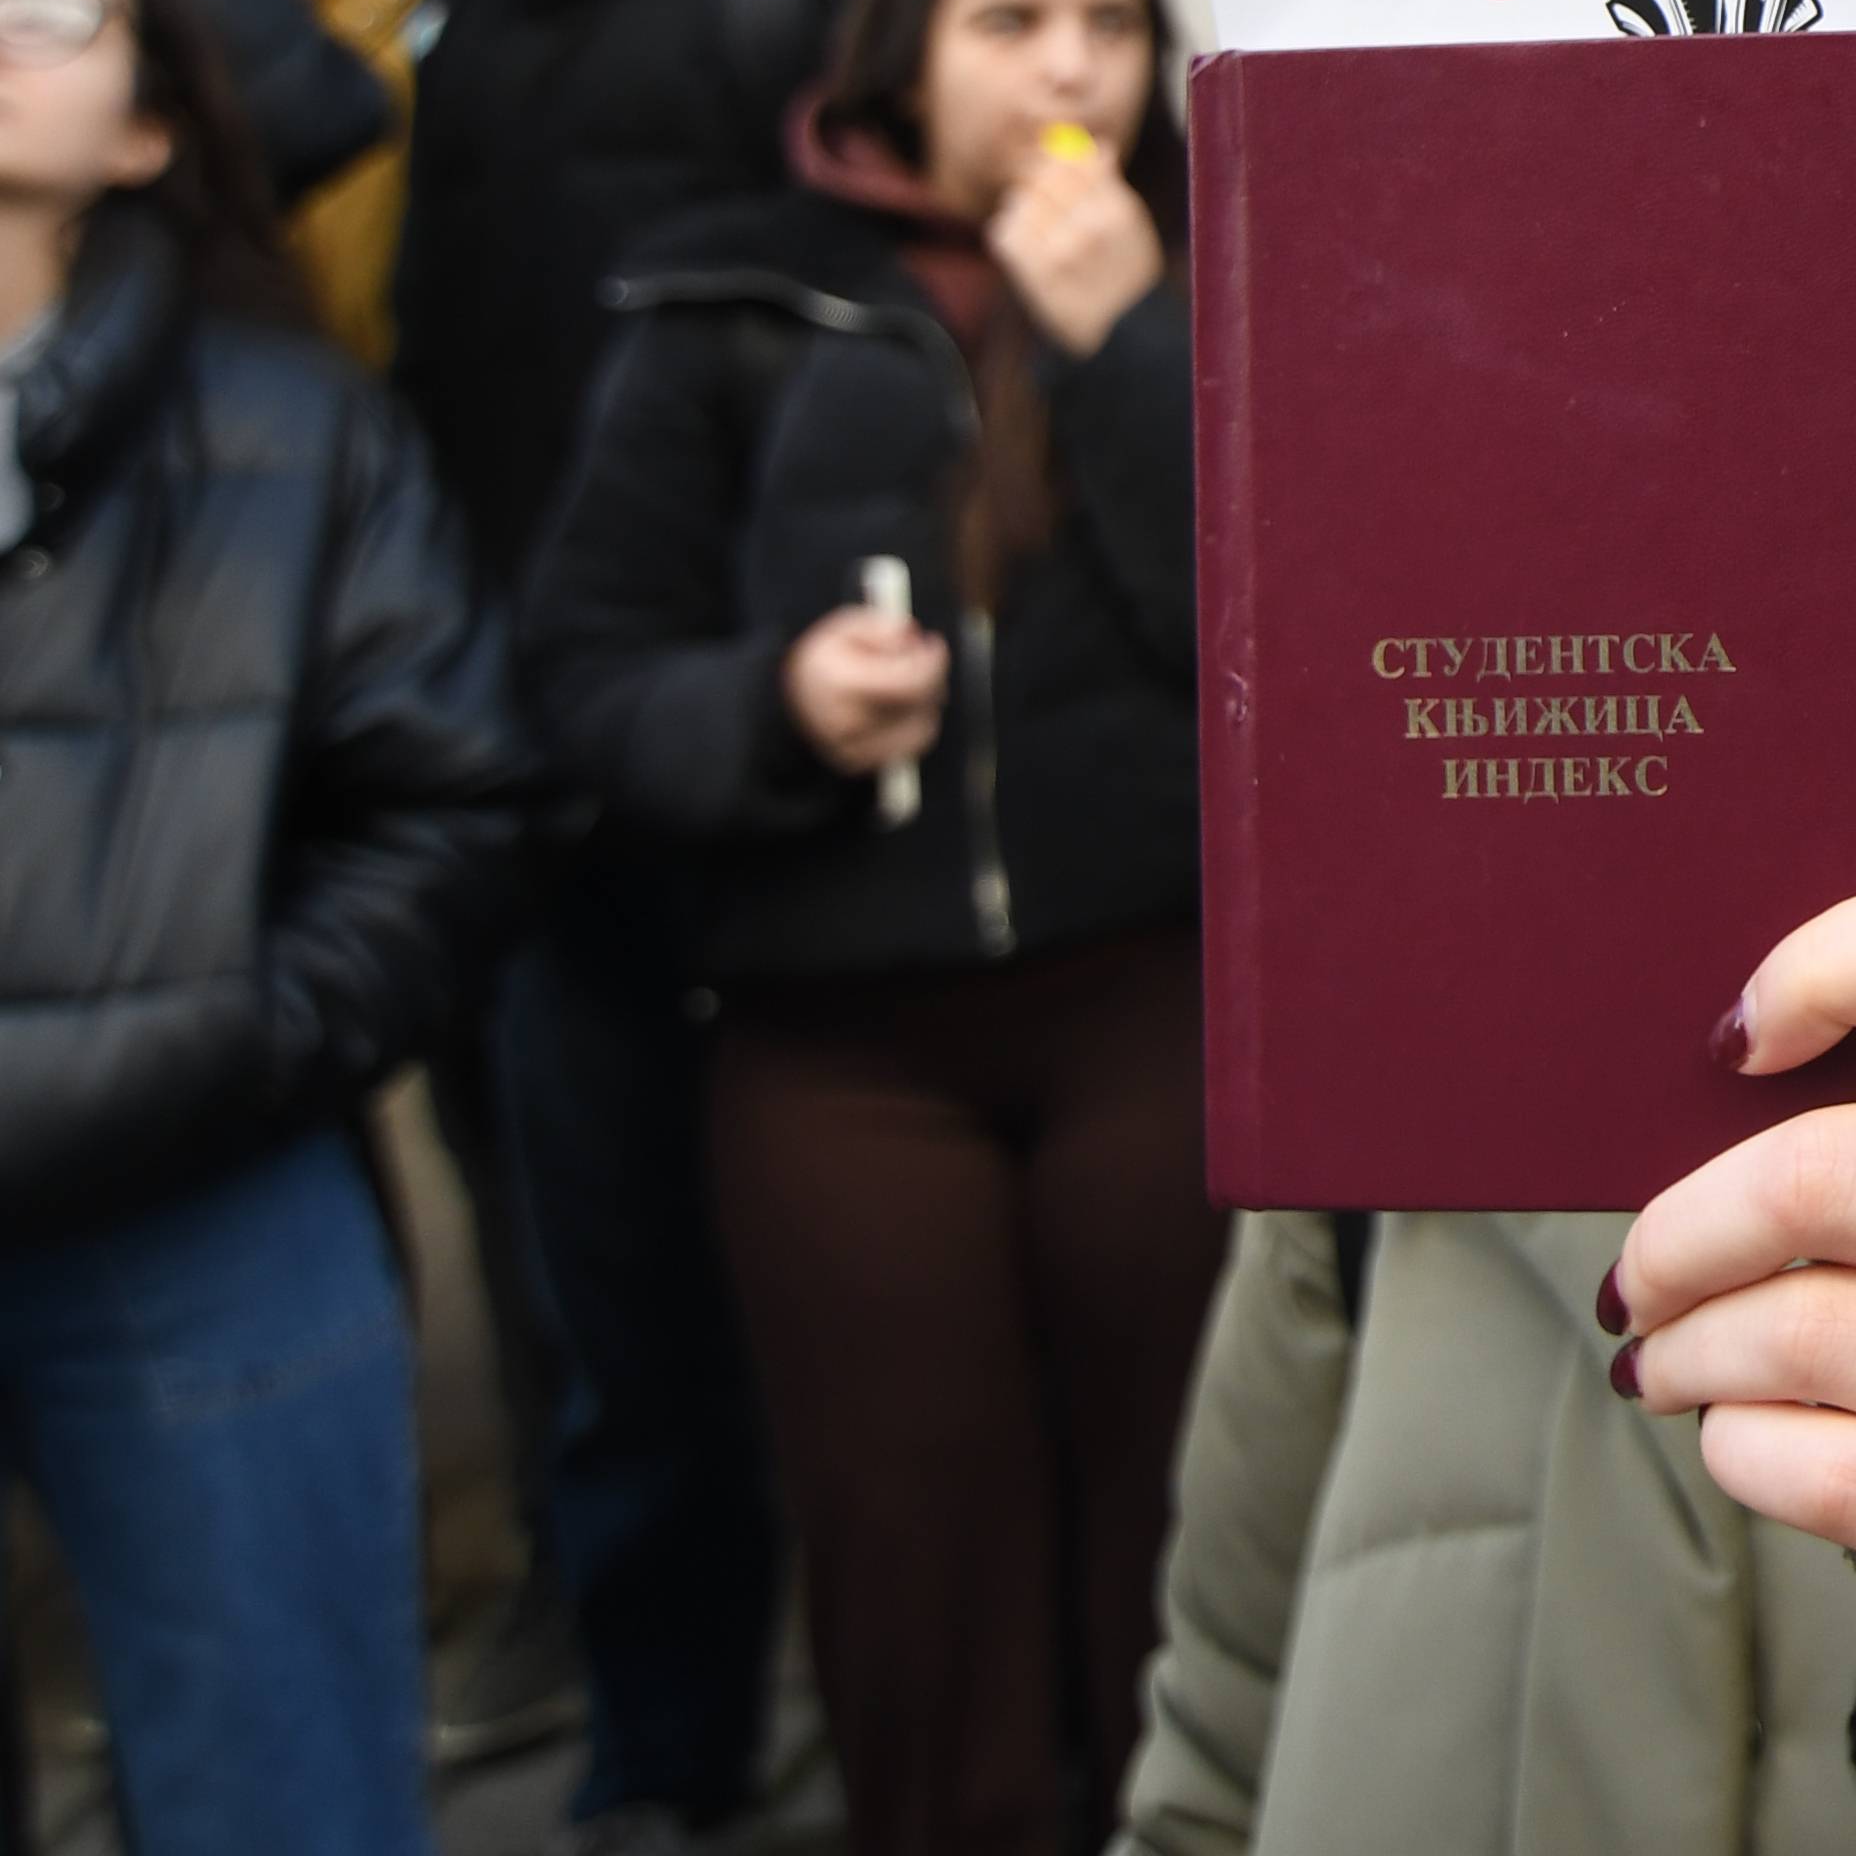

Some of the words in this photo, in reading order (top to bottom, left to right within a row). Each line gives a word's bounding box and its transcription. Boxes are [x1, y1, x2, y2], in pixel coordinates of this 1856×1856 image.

[1370, 631, 1737, 684] СТУДЕНТСКА
[1403, 694, 1705, 743] КЊИЖИЦА
[1442, 755, 1669, 805] ИНДЕКС
